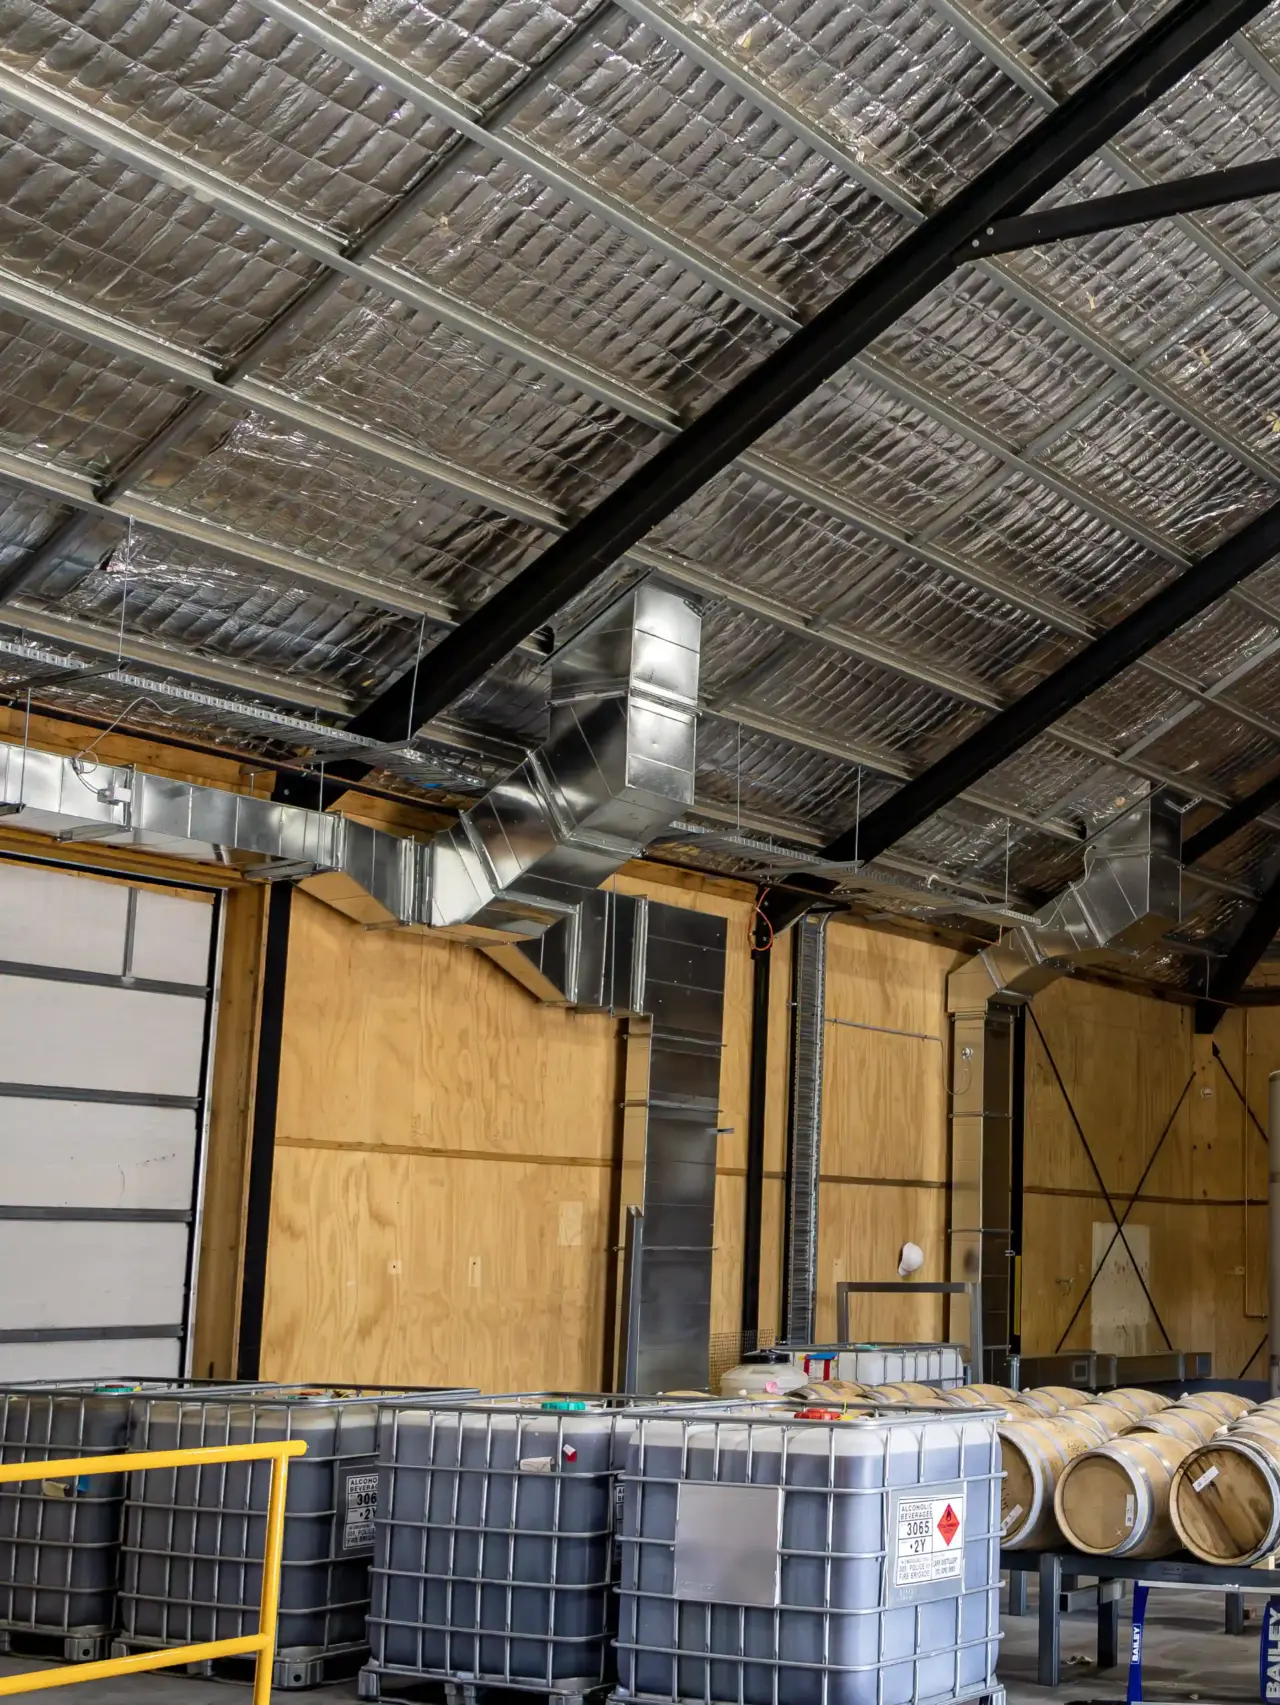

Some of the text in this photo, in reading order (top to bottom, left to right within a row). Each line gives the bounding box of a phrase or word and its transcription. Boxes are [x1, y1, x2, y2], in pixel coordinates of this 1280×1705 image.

[350, 1477, 378, 1486] ALCOHO
[356, 1492, 377, 1506] 306
[901, 1502, 933, 1512] ALCOHOLIC
[901, 1510, 933, 1520] BEVERAGES
[907, 1520, 930, 1536] 3065
[1132, 1627, 1141, 1662] BAILEY
